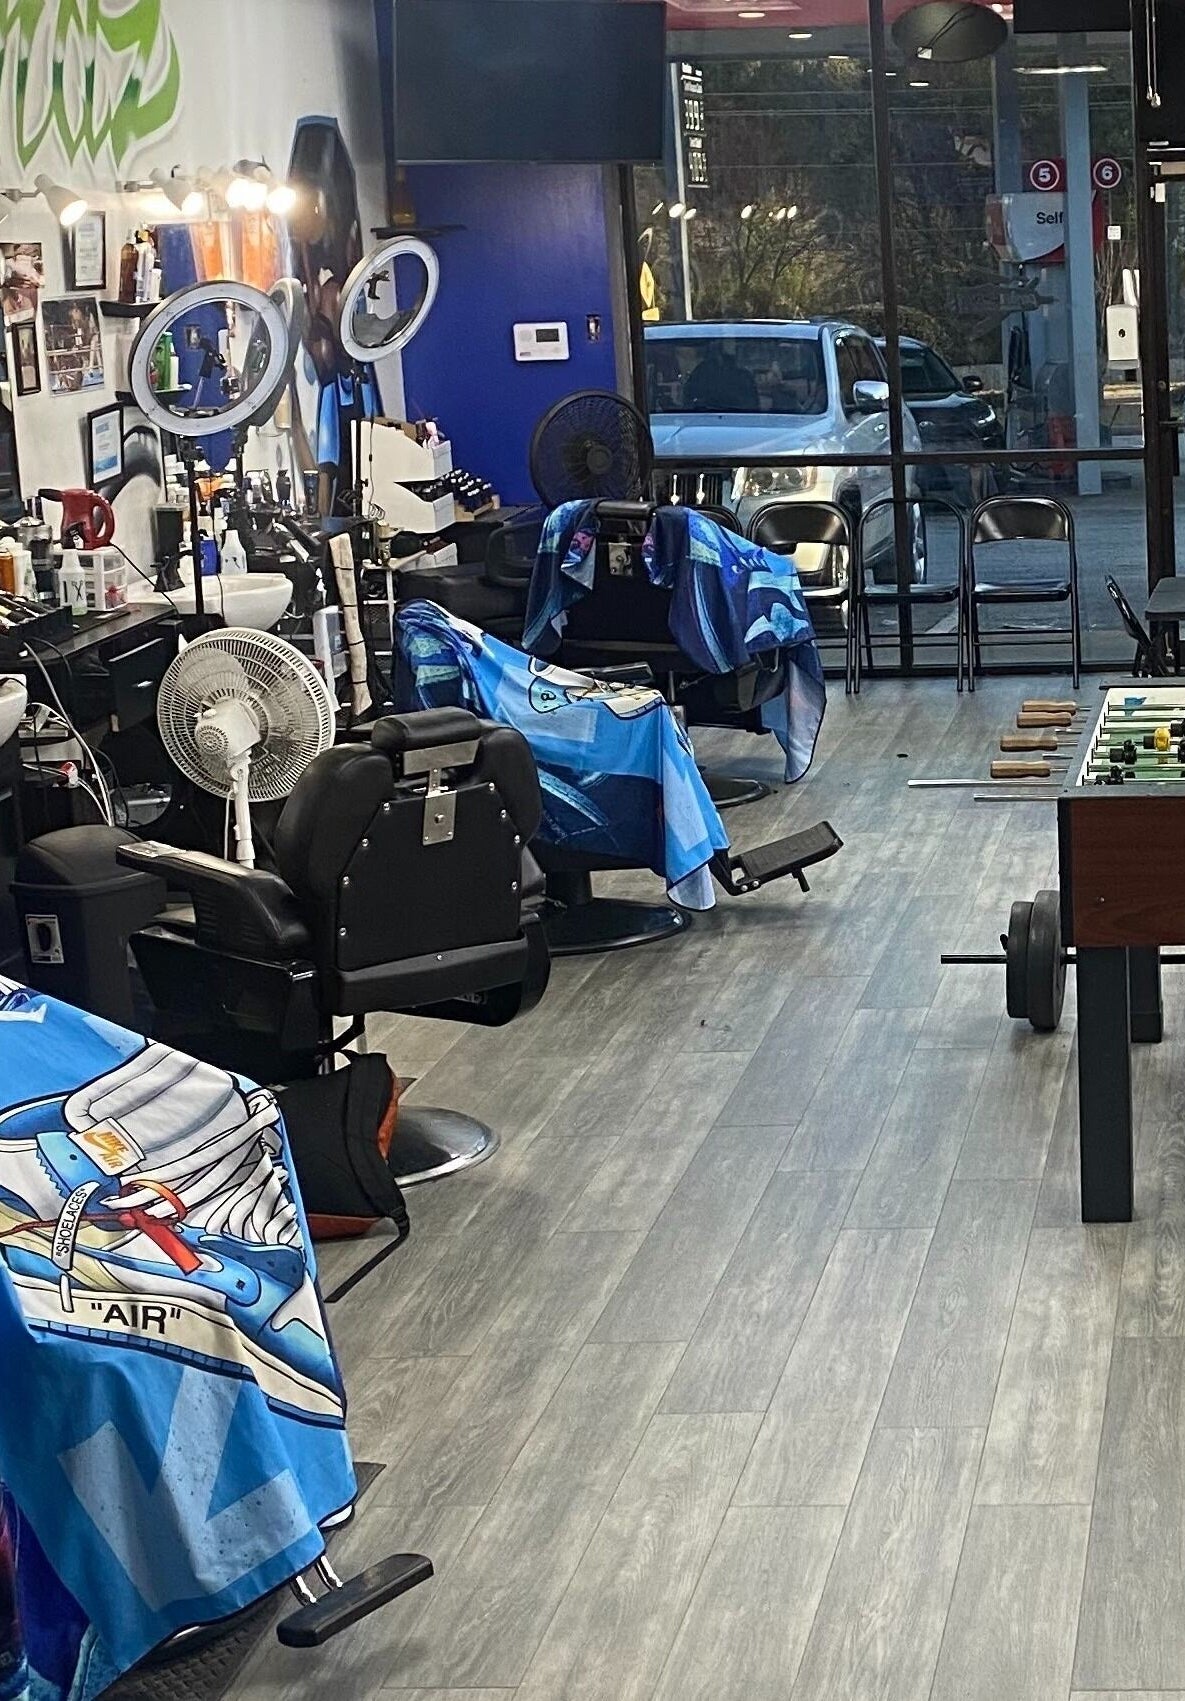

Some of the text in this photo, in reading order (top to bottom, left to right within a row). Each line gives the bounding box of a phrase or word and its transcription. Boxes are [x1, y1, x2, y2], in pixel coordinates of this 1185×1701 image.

[1038, 167, 1052, 183] 5
[1101, 165, 1114, 181] 6
[1036, 211, 1065, 225] Self
[98, 1131, 130, 1154] NIKE
[56, 1188, 87, 1257] "SHOELACES"
[90, 1301, 182, 1335] "AIR"
